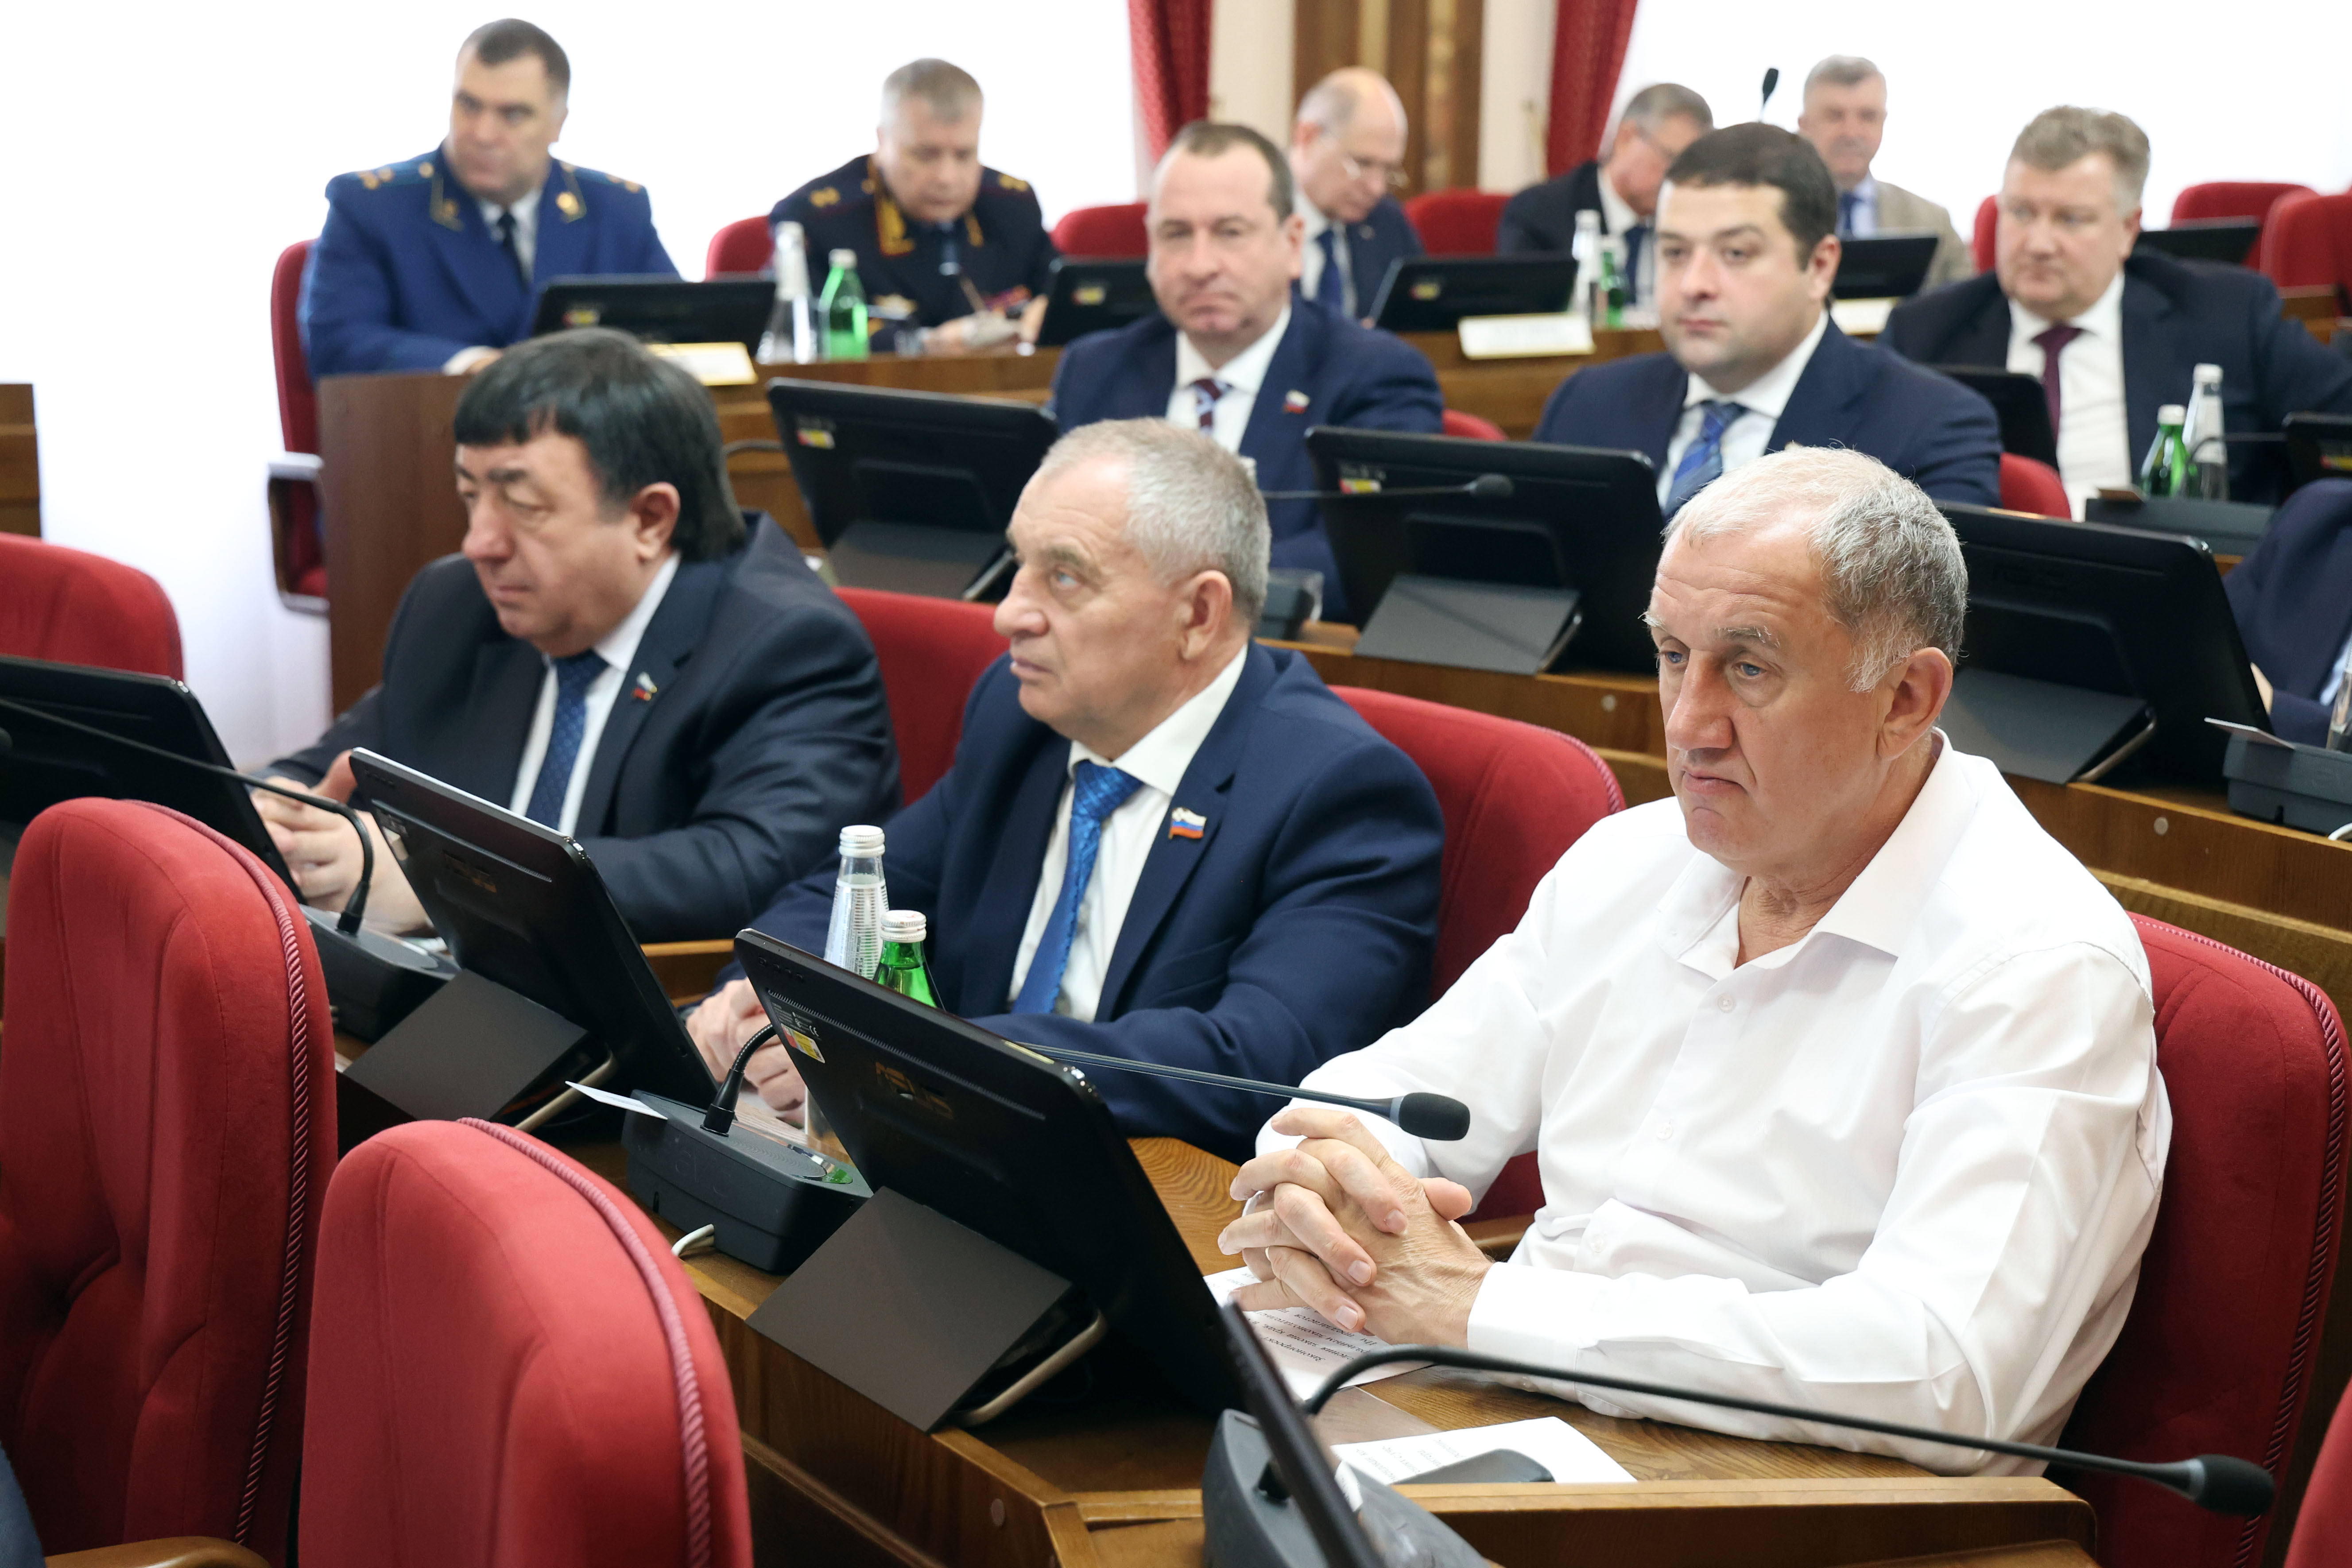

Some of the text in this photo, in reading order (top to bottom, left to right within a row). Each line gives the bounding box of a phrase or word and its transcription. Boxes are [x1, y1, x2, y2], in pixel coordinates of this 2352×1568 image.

[1286, 1334, 1318, 1347] закона
[1327, 1337, 1370, 1354] ральным
[1321, 1347, 1354, 1360] едения
